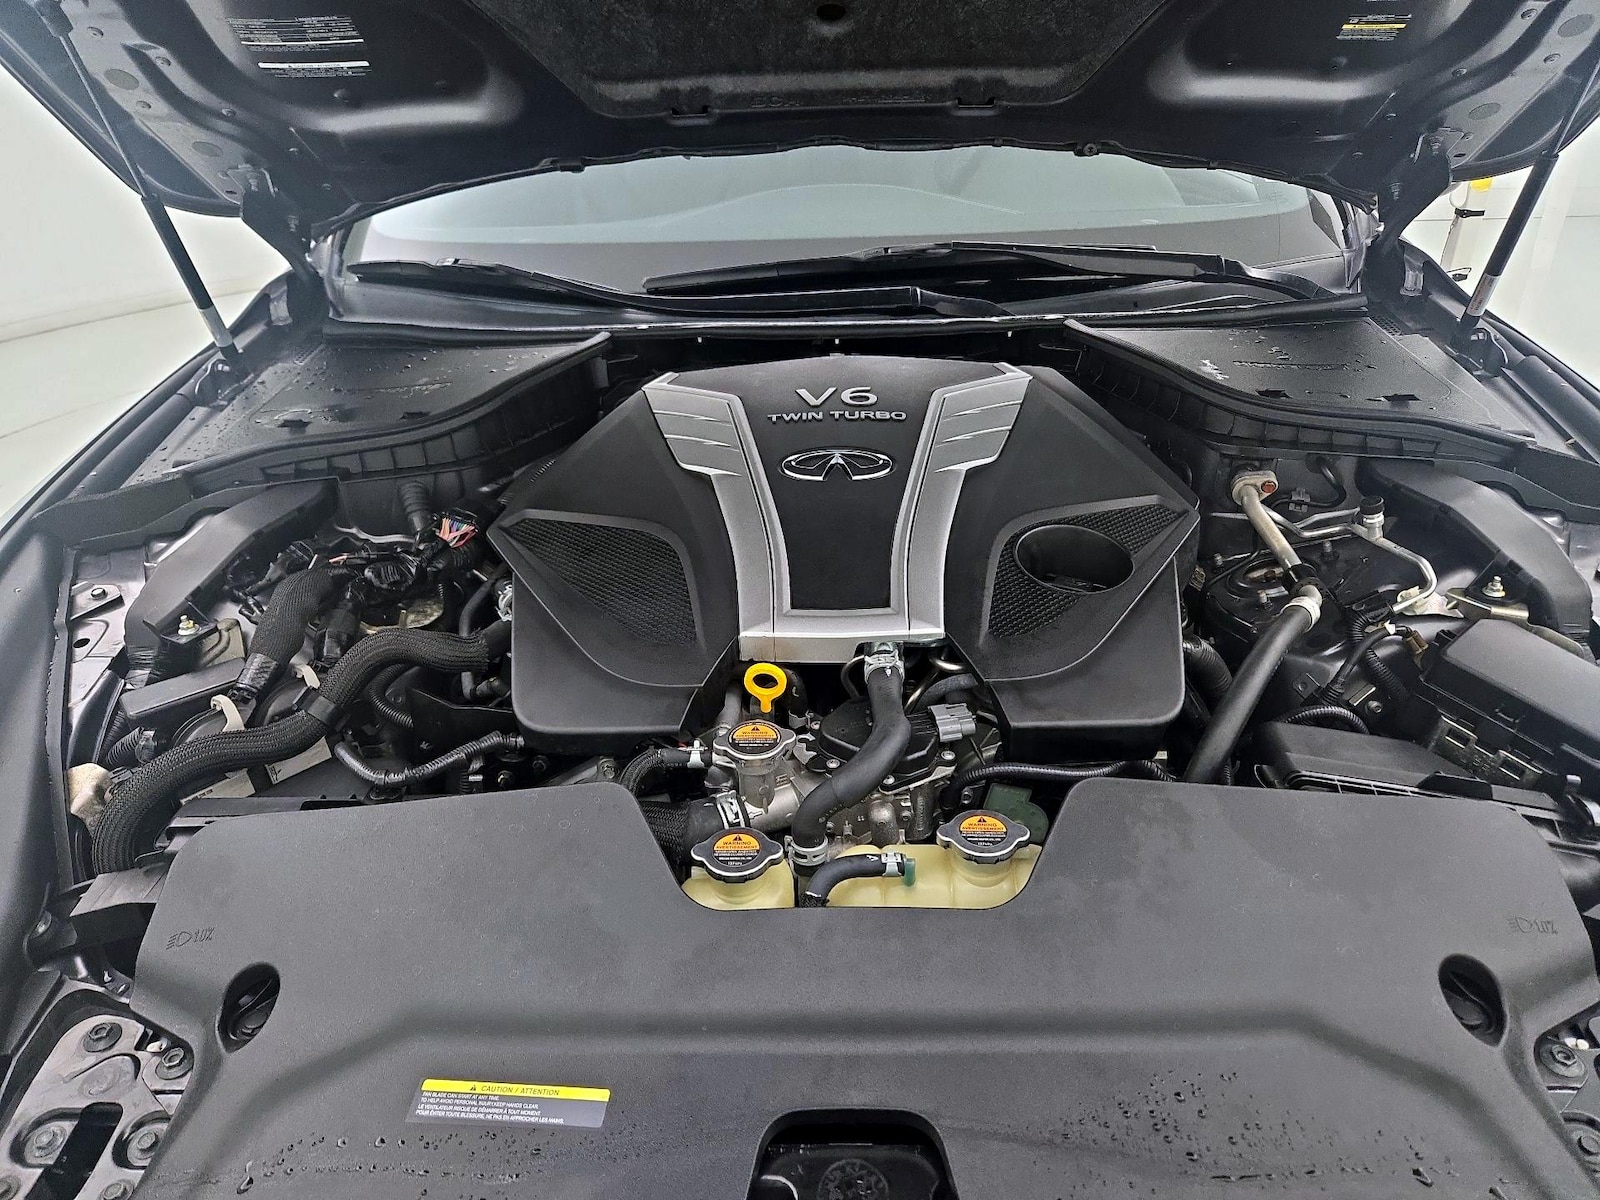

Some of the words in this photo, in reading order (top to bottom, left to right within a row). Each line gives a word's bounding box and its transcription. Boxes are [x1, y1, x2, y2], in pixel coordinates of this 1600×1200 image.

[795, 386, 878, 406] V6
[767, 411, 823, 423] TWIN
[830, 410, 907, 421] TURBO
[481, 1085, 512, 1093] CAUTION
[520, 1088, 560, 1096] ATTENTION
